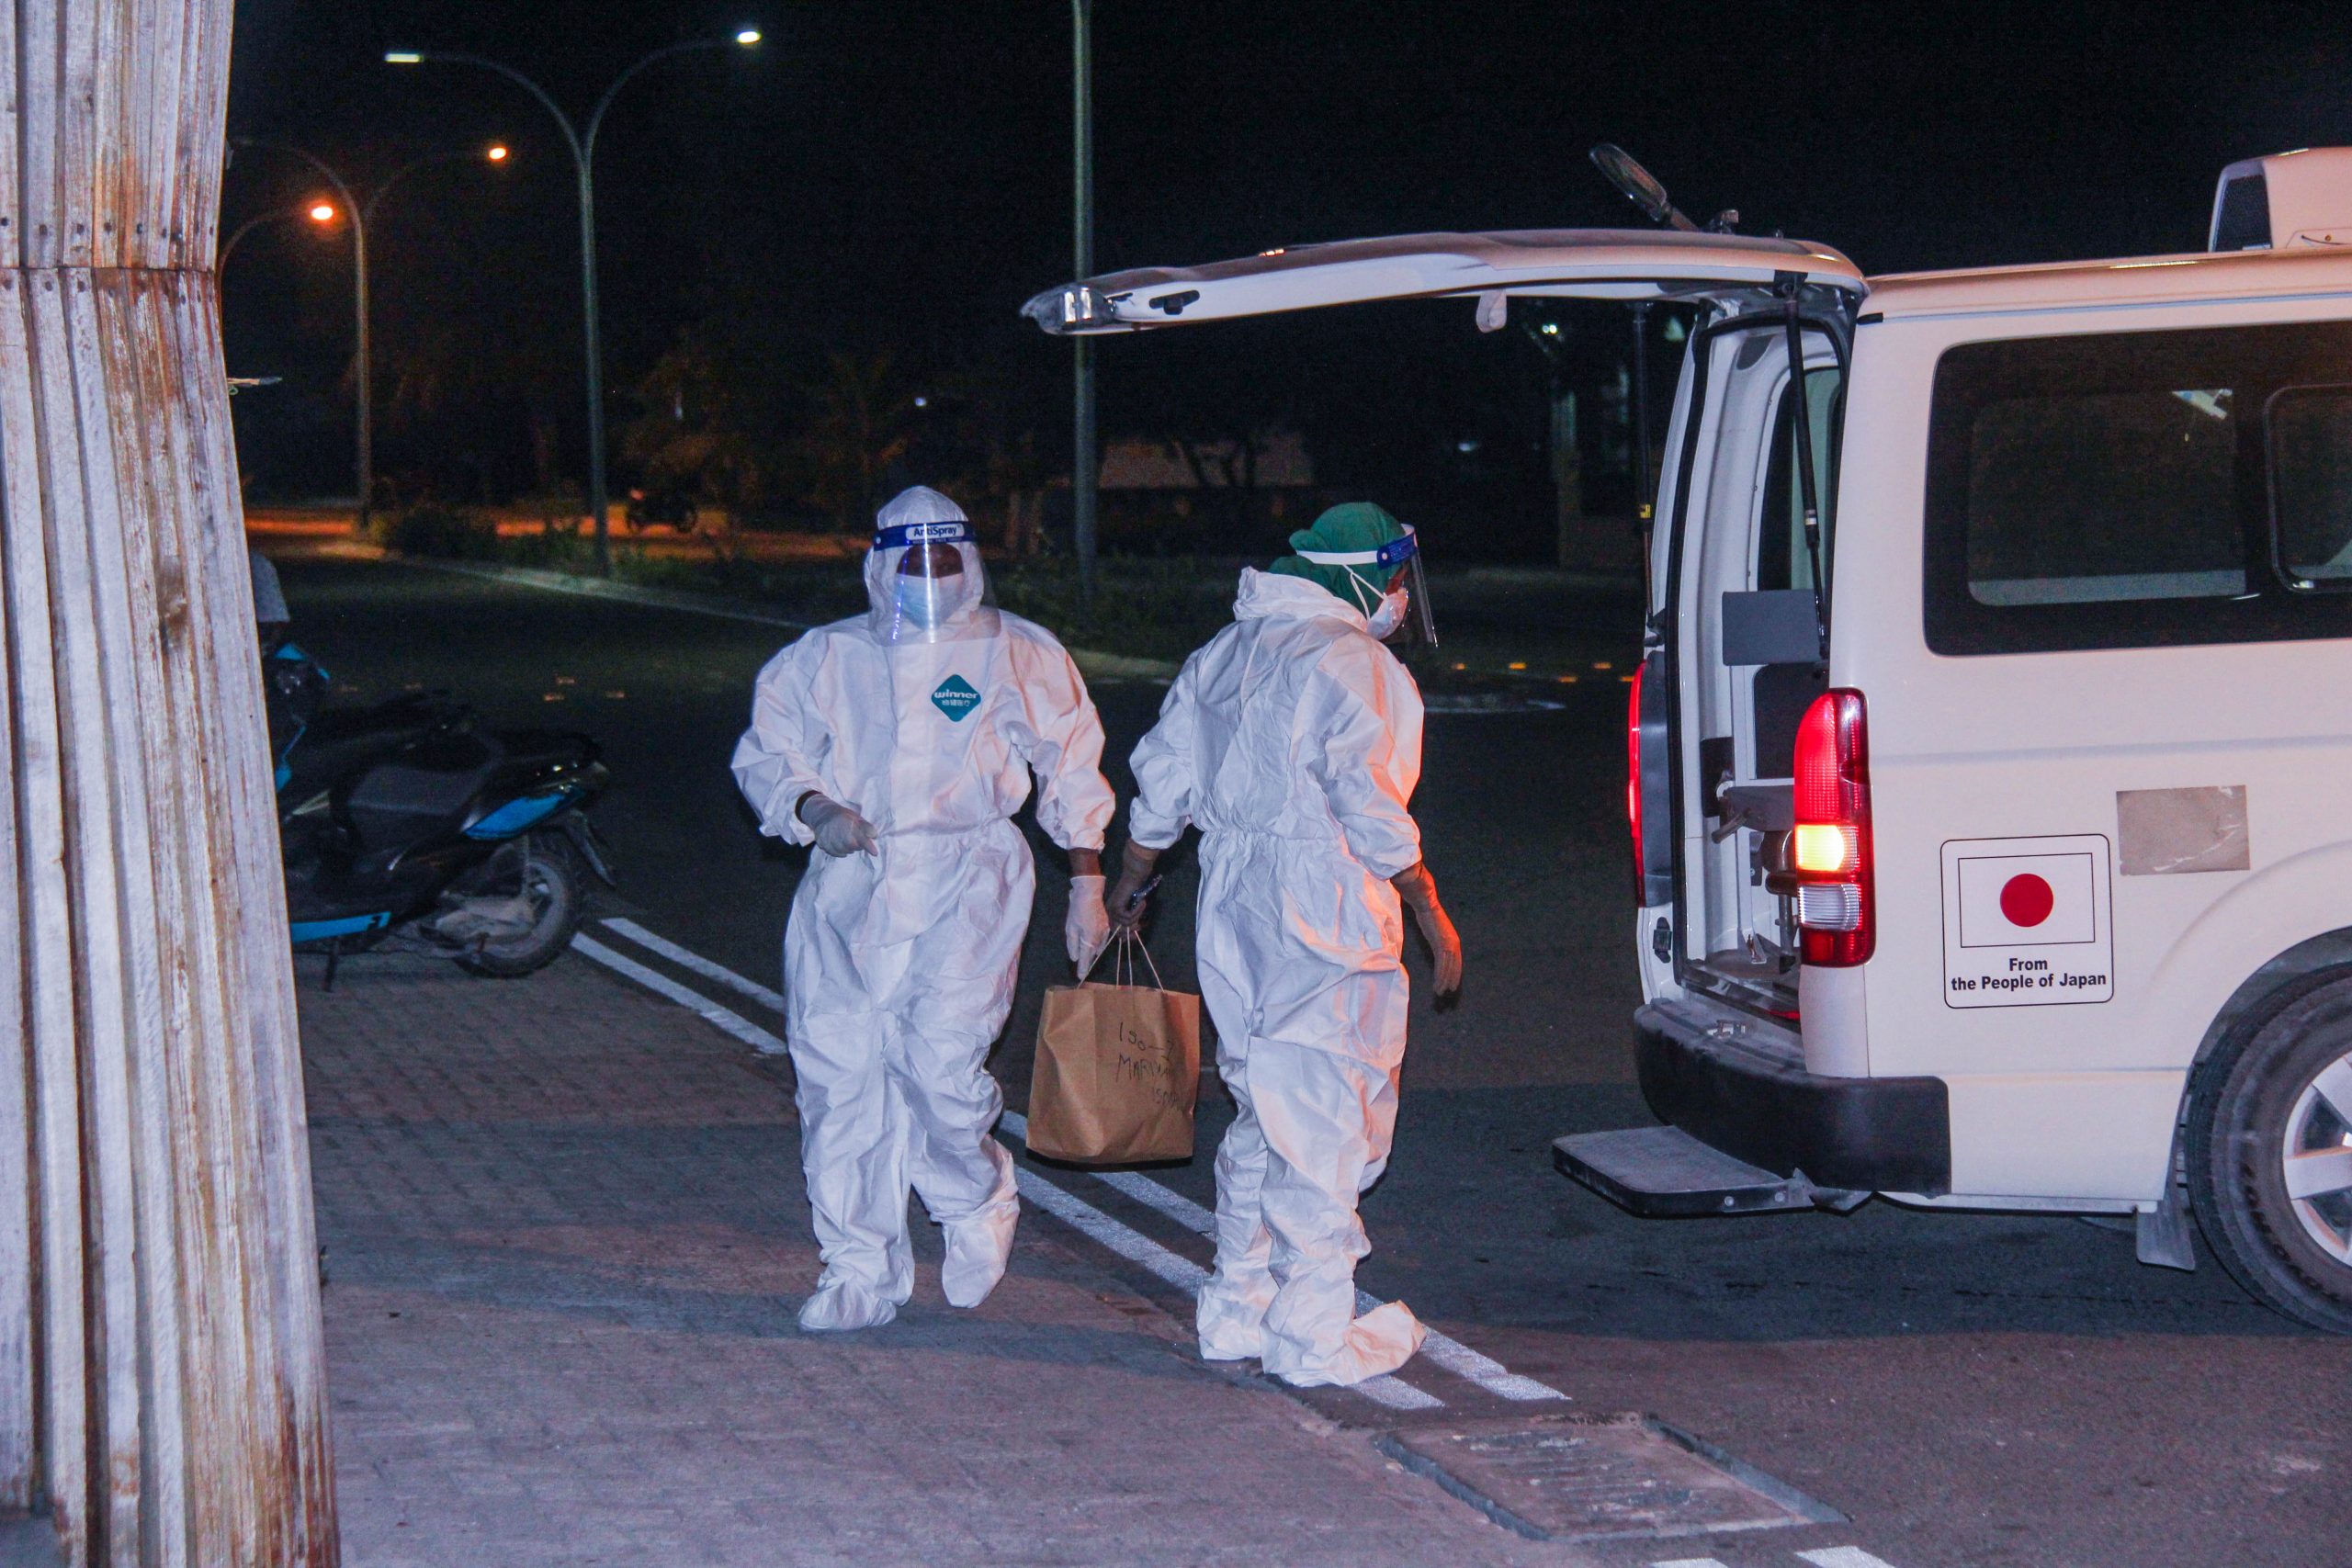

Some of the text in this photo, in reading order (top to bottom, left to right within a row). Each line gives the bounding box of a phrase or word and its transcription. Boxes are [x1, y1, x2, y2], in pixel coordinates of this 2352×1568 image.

[933, 688, 978, 699] winner
[2008, 957, 2048, 971] From
[1951, 973, 2107, 991] the People of Japan
